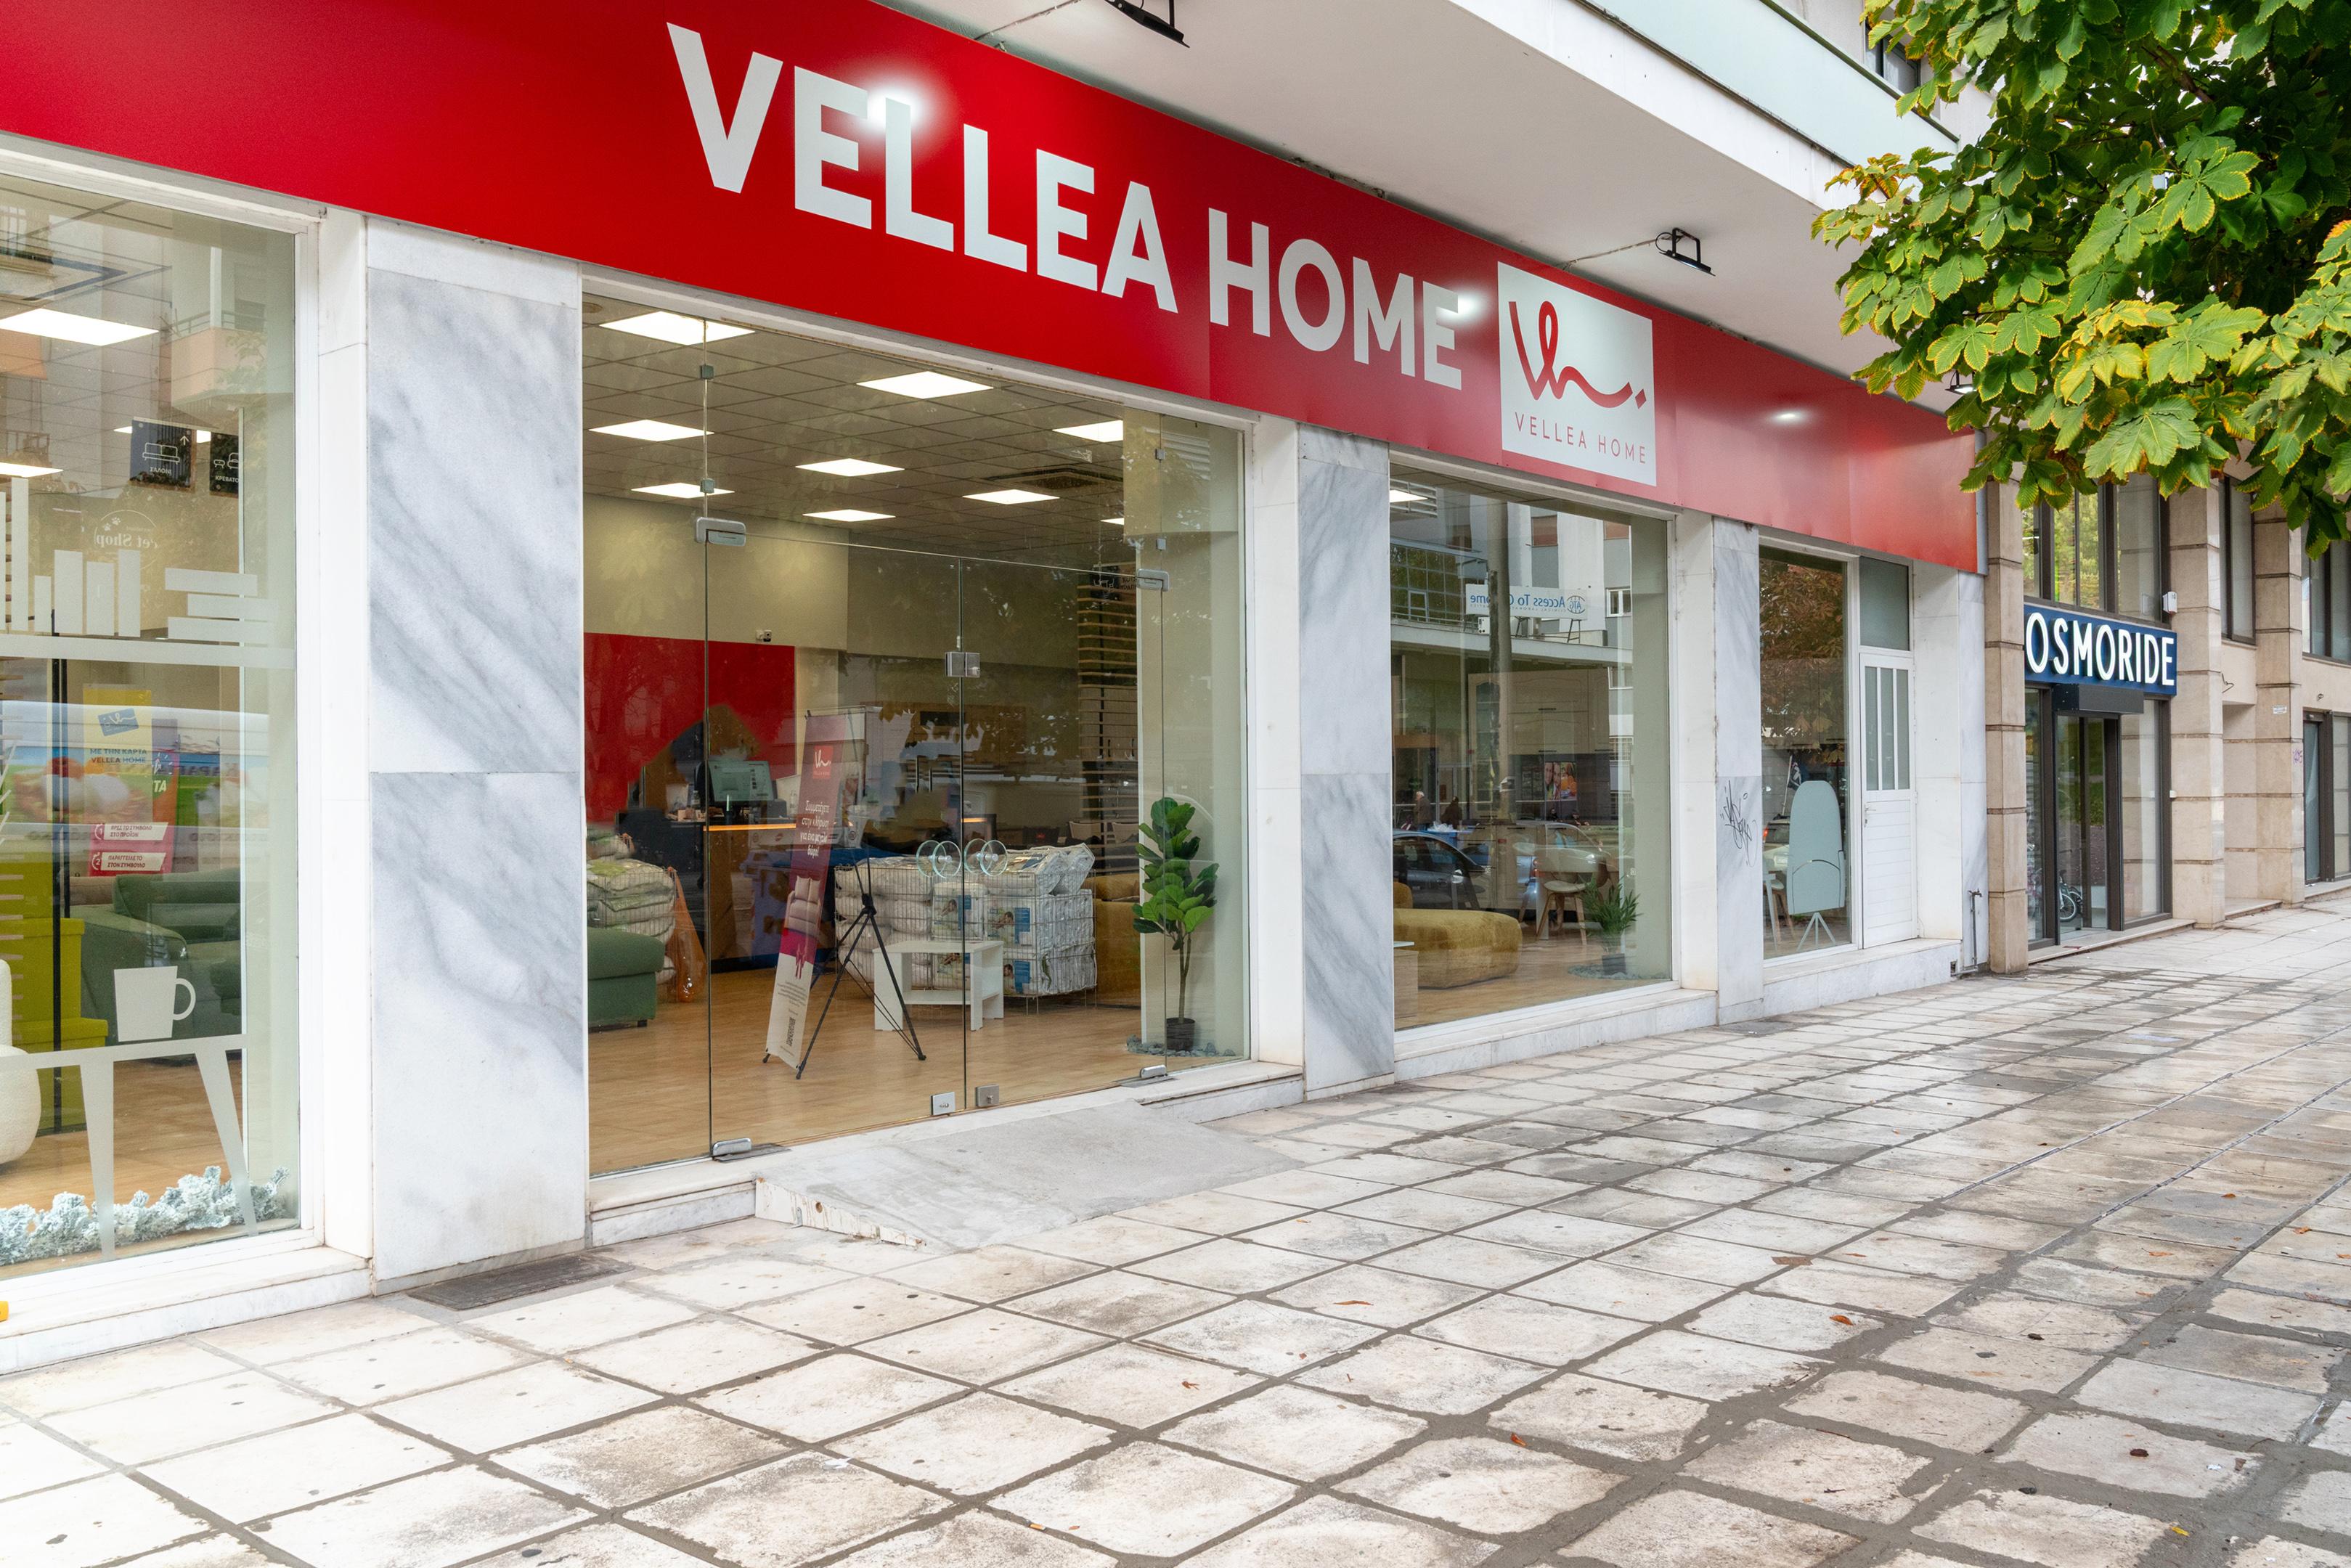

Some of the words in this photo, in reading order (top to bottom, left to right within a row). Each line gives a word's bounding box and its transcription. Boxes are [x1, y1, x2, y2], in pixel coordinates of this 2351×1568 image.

[667, 22, 1178, 314] VELLEA
[1209, 208, 1462, 391] HOME
[1515, 412, 1587, 449] VELLEA
[1598, 434, 1646, 465] HOME
[150, 466, 172, 475] ΣΑΛΟΝΙ
[215, 475, 239, 483] ΚΡΕΒΑΤΟ
[2026, 612, 2175, 686] OSMORIDE
